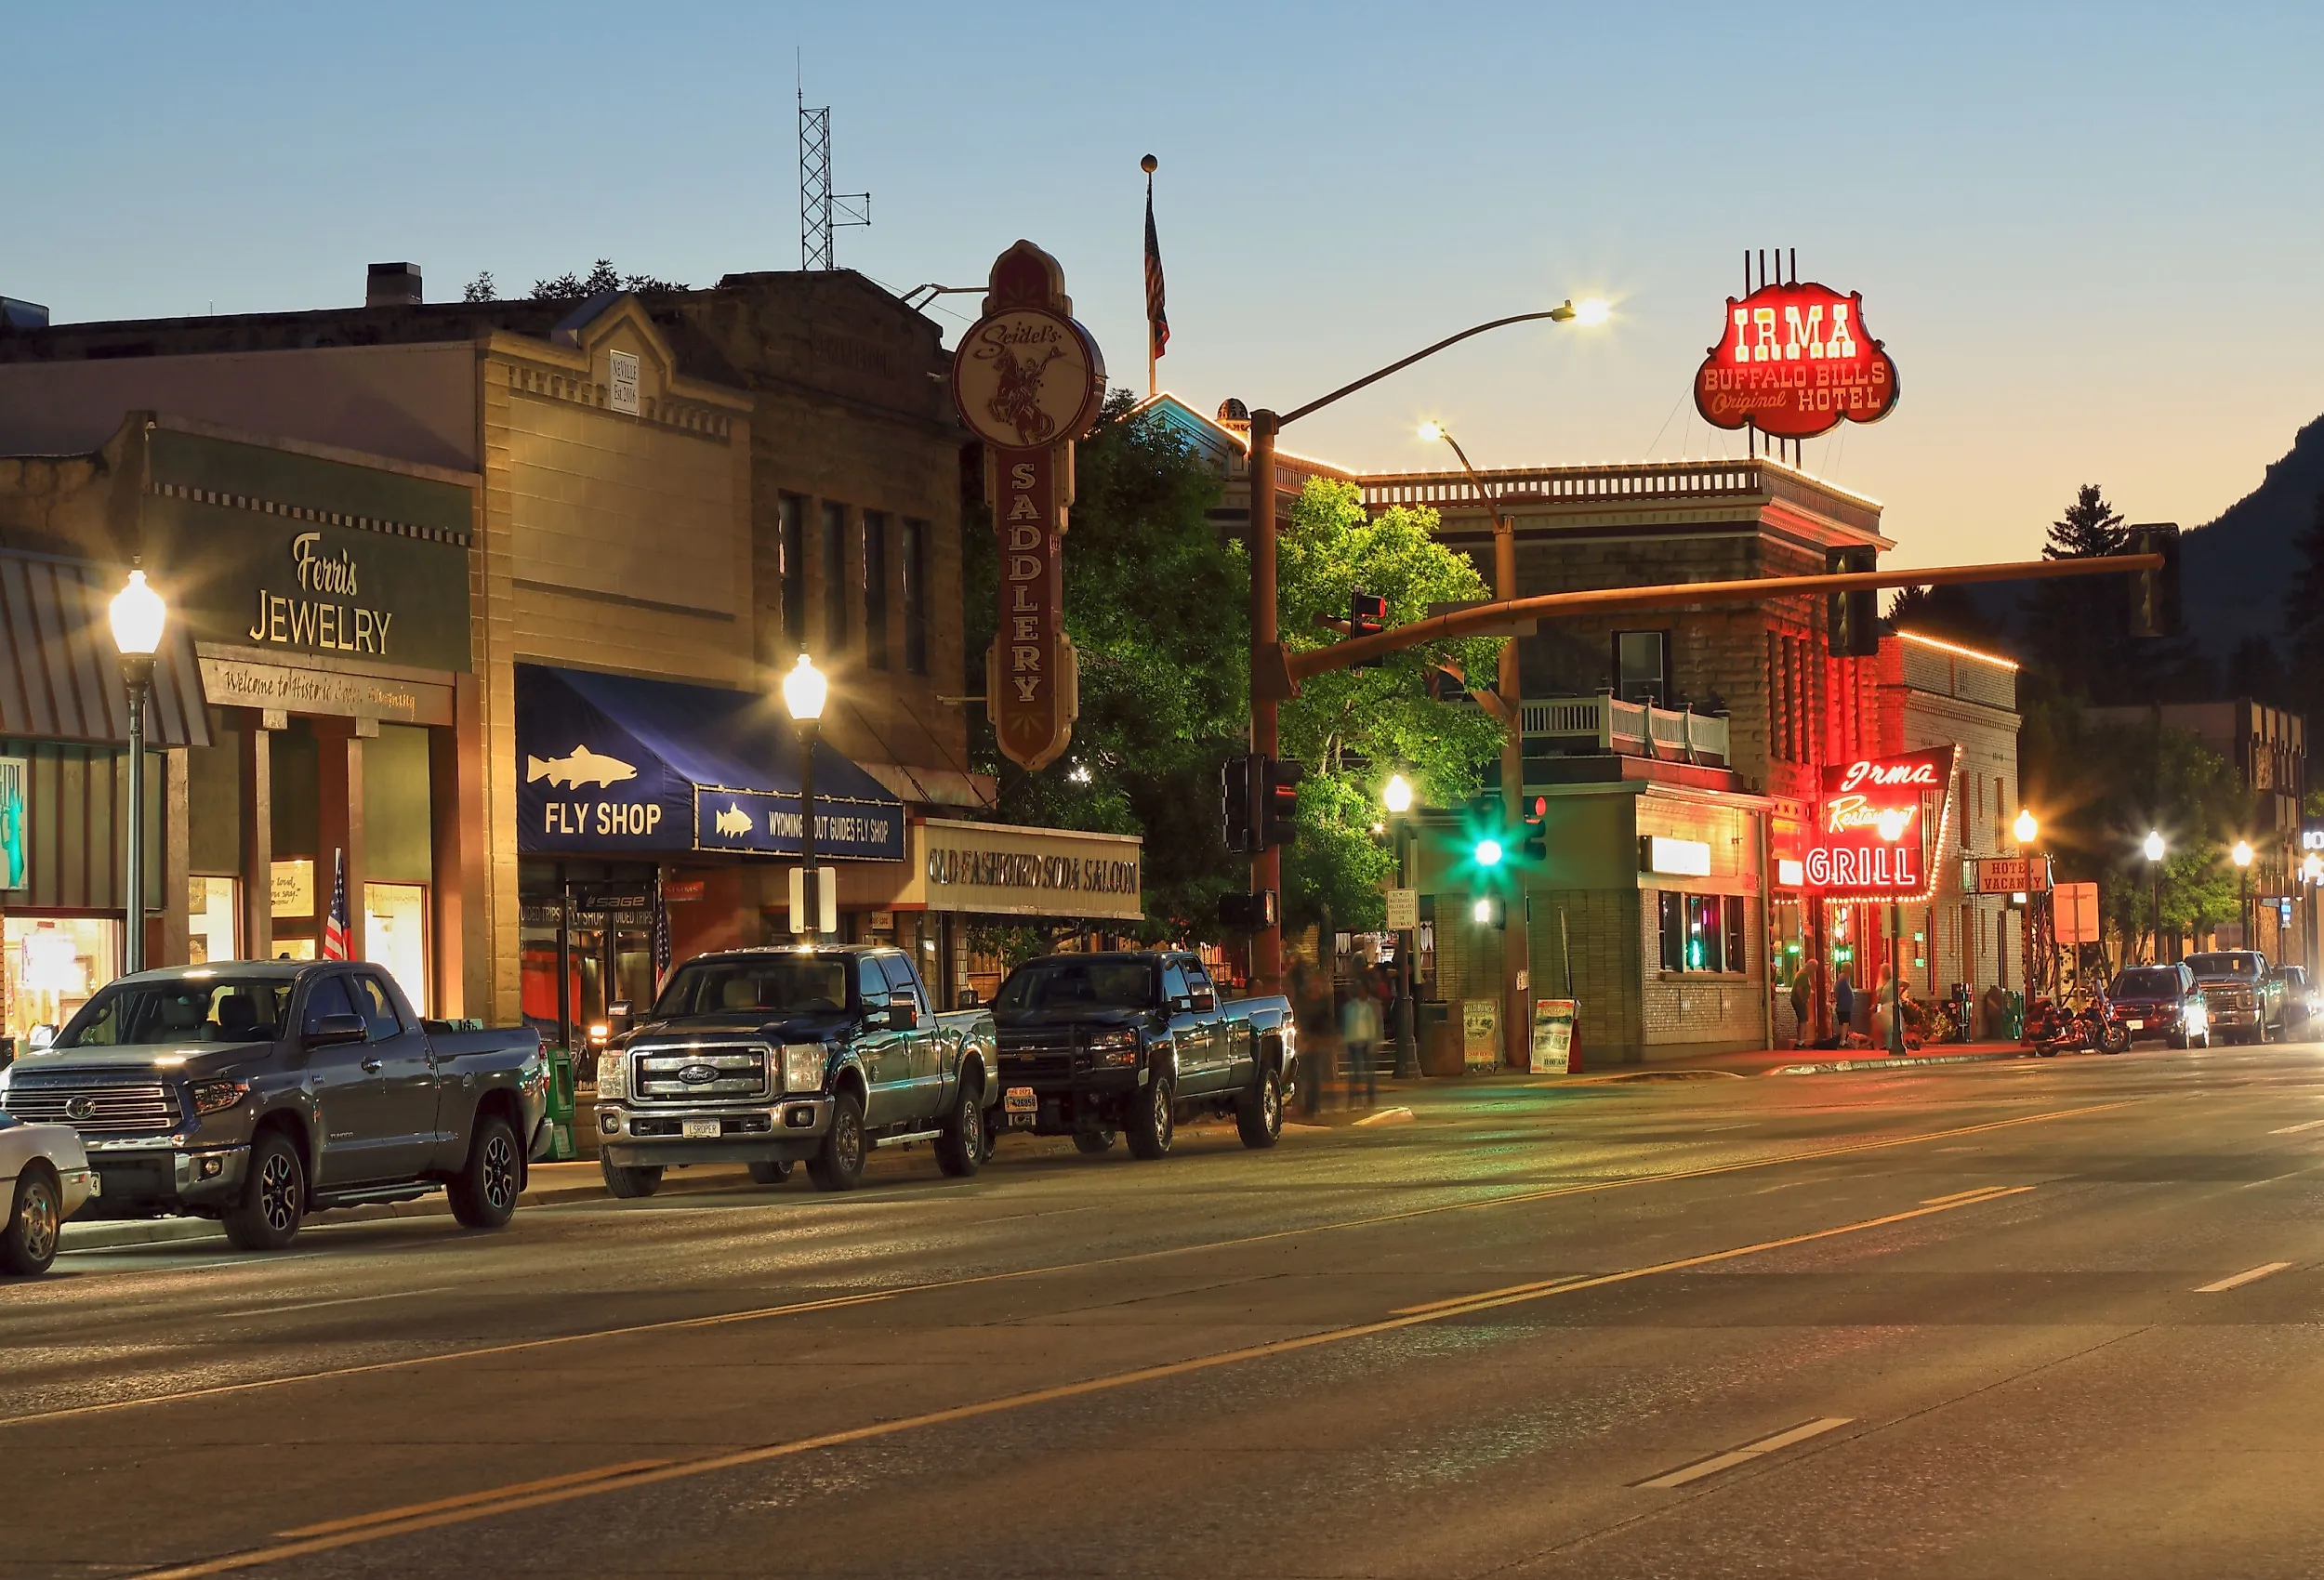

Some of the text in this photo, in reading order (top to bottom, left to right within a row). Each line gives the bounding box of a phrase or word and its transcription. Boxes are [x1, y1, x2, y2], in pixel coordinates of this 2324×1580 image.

[973, 321, 1058, 360] Seidel's
[1734, 303, 1857, 363] IRMA
[1704, 362, 1885, 390] BUFFALO BILLS
[1711, 386, 1882, 415] Original HOTEL
[293, 532, 357, 596] Ferris
[1006, 463, 1042, 702] SADDLERY
[249, 589, 392, 655] JEWELRY
[225, 669, 273, 696] Welcome
[278, 676, 288, 697] to
[290, 670, 331, 701] Historic
[1840, 760, 1938, 792] Irma
[545, 802, 662, 835] FLY SHOP
[768, 811, 803, 837] WYOMING
[829, 816, 856, 841] GUIDES
[856, 818, 869, 842] FLY
[870, 819, 889, 843] SHOP
[930, 848, 1137, 894] OLD FASHIONED SODA SALOON
[1806, 848, 1916, 885] GRILL
[1991, 862, 2034, 875] HOTE
[1984, 877, 2042, 889] VACANY
[542, 905, 560, 923] TRIPS
[686, 1066, 708, 1078] Ford
